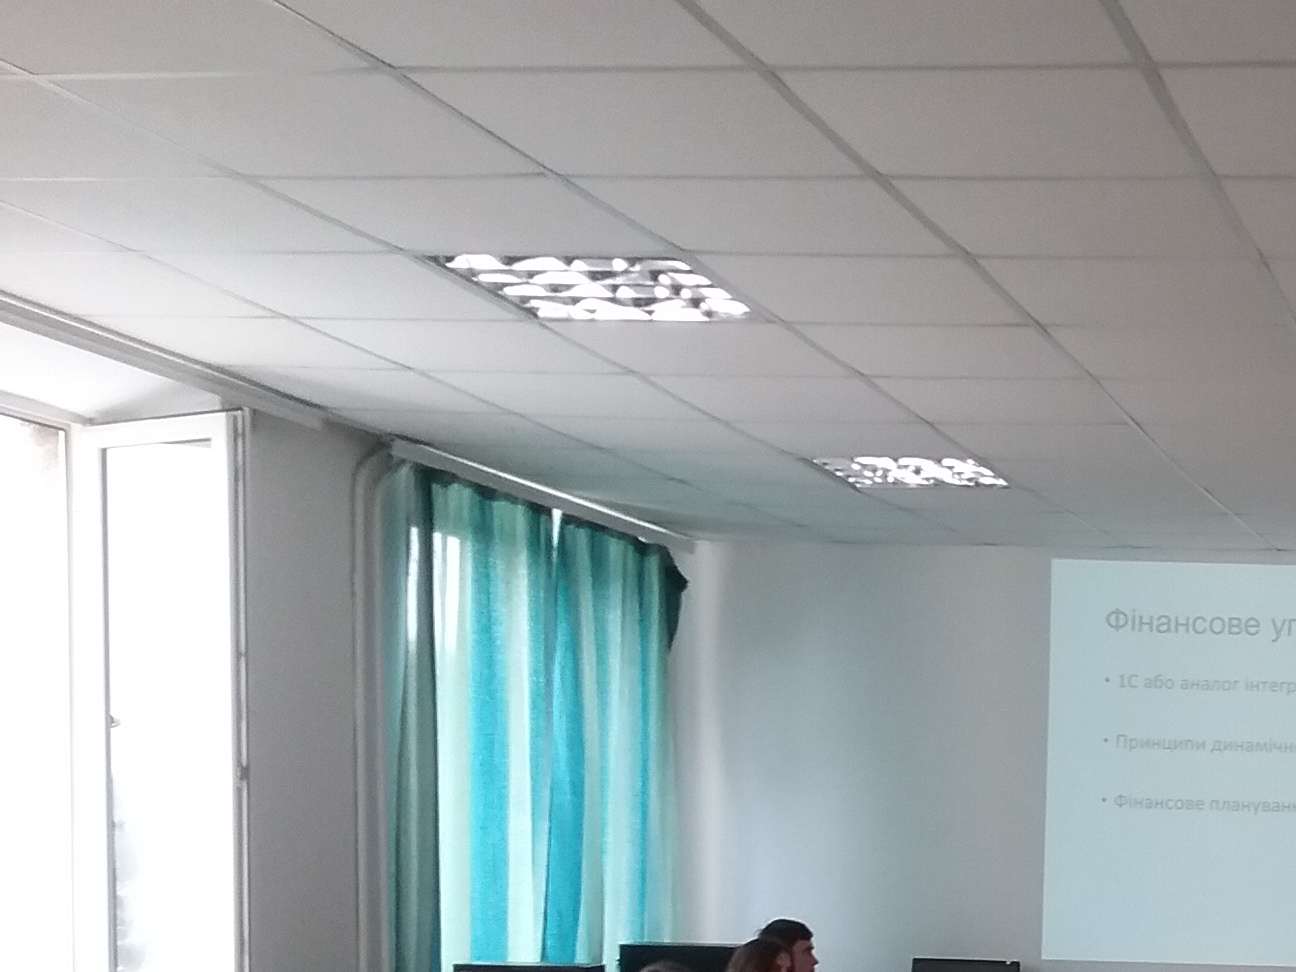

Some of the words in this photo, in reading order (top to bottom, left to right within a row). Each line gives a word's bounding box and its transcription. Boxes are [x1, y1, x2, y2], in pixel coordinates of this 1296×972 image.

[1105, 607, 1261, 636] Фінансове
[1143, 674, 1175, 690] або
[1179, 678, 1240, 693] аналог
[1115, 733, 1206, 752] Принципи
[1113, 793, 1205, 811] Фінансове
